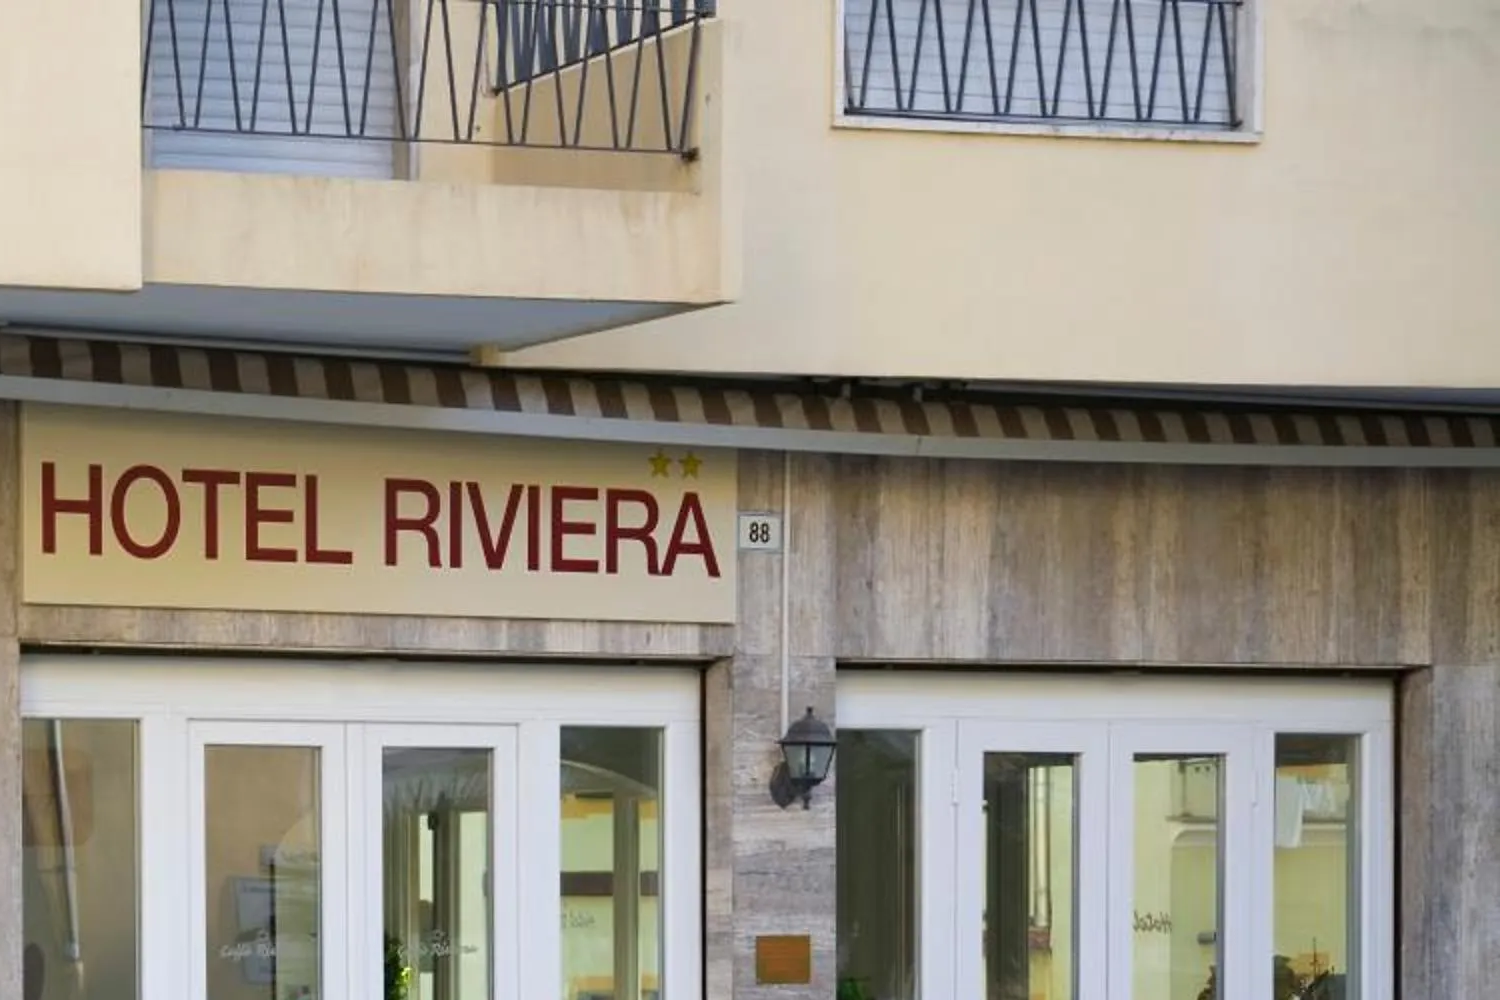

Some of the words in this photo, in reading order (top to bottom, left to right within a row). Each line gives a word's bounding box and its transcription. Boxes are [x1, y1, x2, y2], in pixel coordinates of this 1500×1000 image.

[41, 461, 353, 565] HOTEL
[384, 477, 720, 577] RIVIERA
[749, 521, 770, 543] 88
